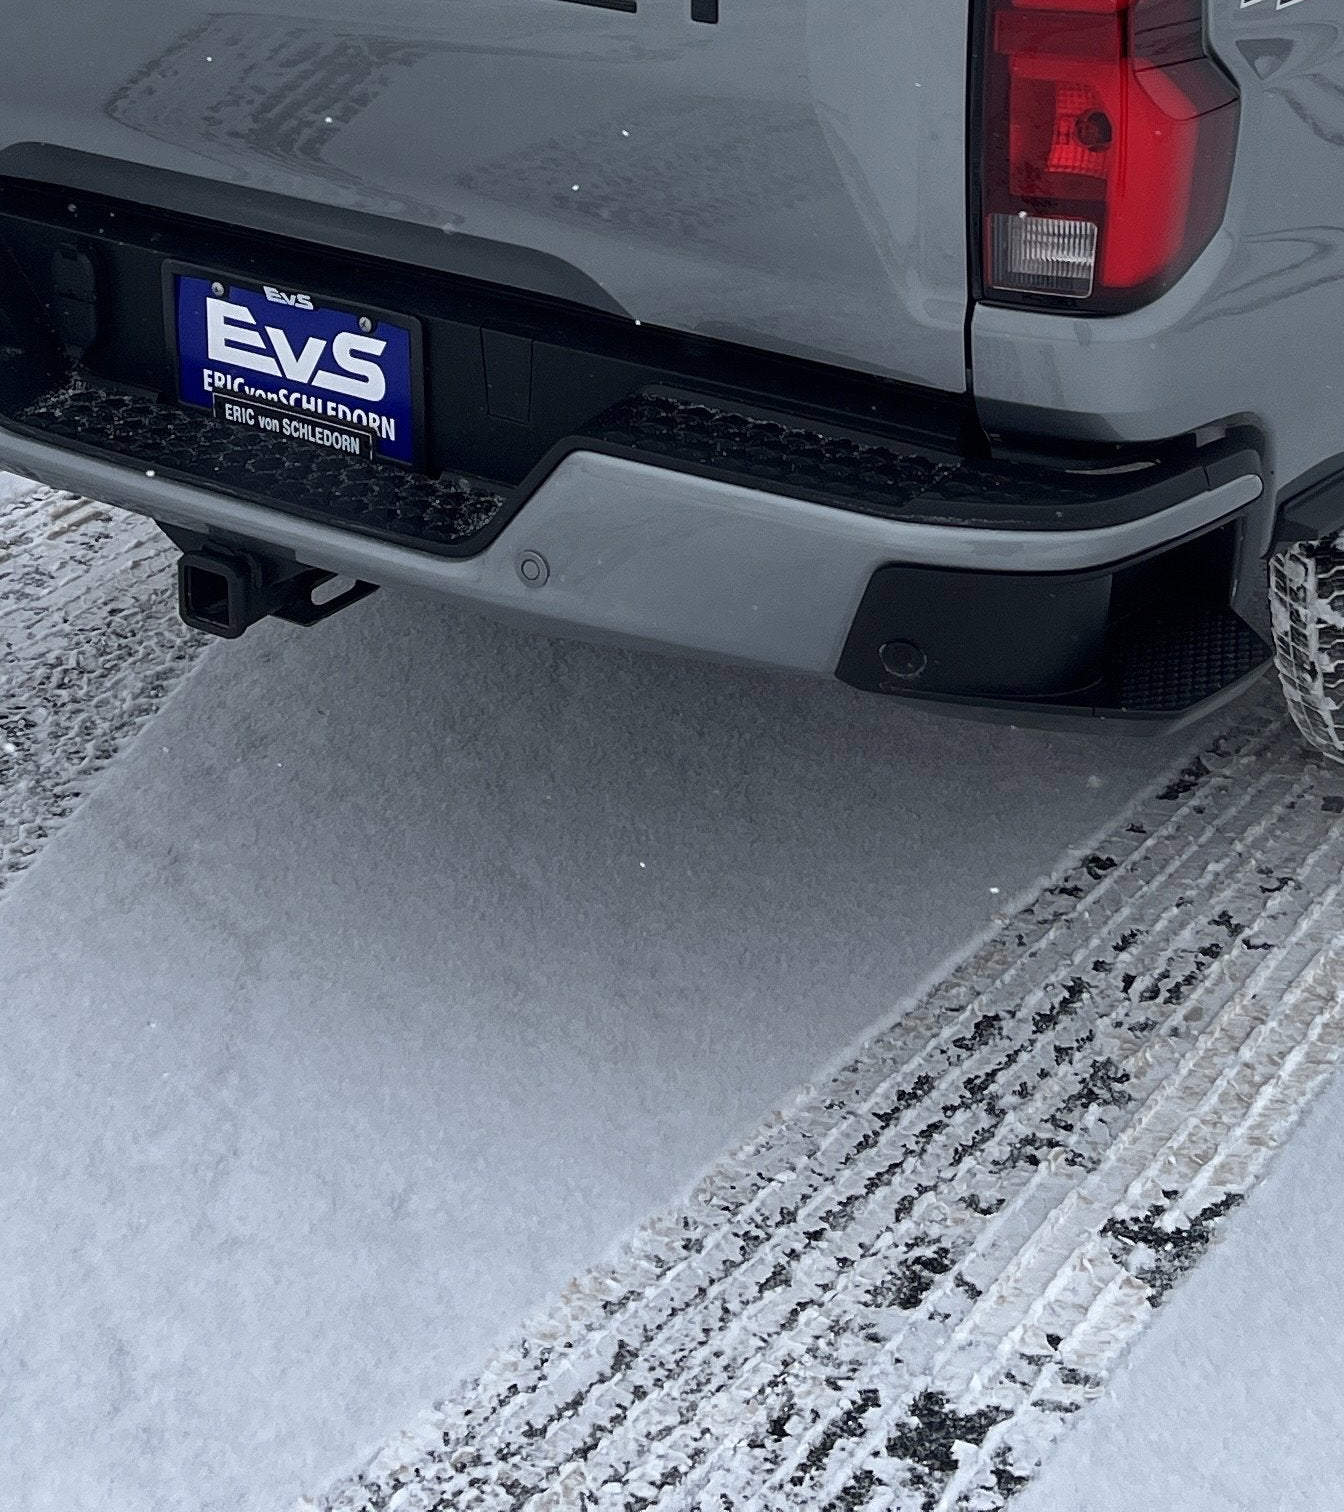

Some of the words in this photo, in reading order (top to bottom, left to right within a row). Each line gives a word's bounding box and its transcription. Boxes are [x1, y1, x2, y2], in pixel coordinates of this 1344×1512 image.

[225, 403, 255, 425] ERIC
[258, 415, 280, 433] von
[282, 418, 360, 455] SCHLEDORN
